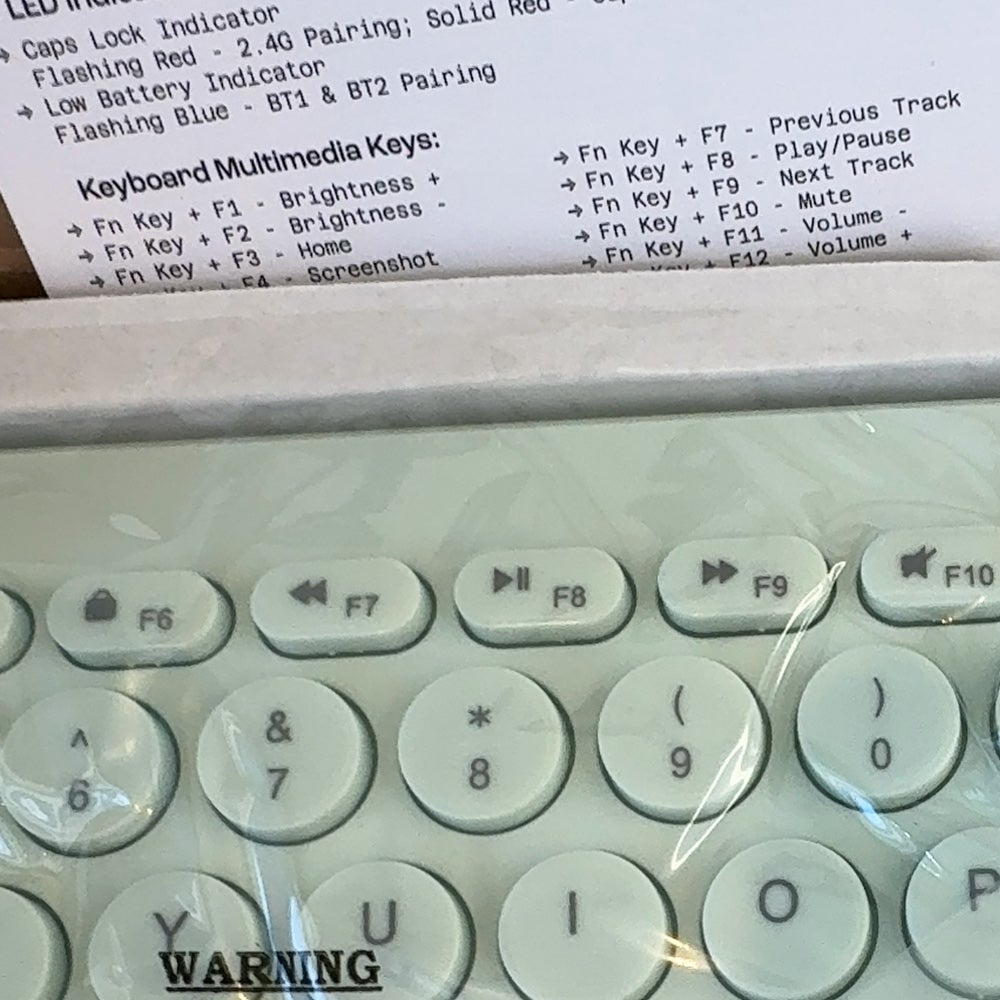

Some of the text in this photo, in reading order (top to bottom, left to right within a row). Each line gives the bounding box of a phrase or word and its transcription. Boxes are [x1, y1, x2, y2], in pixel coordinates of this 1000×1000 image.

[22, 37, 78, 60] Caps
[89, 22, 146, 49] Lock
[156, 5, 280, 40] Indicator
[32, 0, 551, 88] Flashing Red 2.4G Pairing; Solid Red
[44, 58, 326, 117] Low Battery Indicator
[54, 62, 496, 144] Flashing Blue BT1 & BT2 Pairing
[578, 89, 962, 163] Fn Key F7 Previous Track
[76, 131, 440, 202] Keyboard Multimedia Keys:
[585, 127, 911, 189] Fn Key F8 Play/Pause
[592, 150, 915, 214] Fn Key F9 Next Track
[93, 175, 414, 237] Fn Key F1 Brightness
[599, 188, 852, 240] Fn Key F10 Mute
[104, 201, 423, 262] Fn Key F2 Brightness
[605, 209, 883, 264] Fn Key F11 Volume
[729, 232, 888, 267] F12 Volume
[115, 238, 352, 286] Fn Key F3 Home
[307, 249, 439, 284] Screenshot
[553, 586, 587, 609] F8
[754, 575, 789, 598] F9
[945, 565, 995, 587] F10
[139, 609, 174, 631] F6
[346, 594, 380, 618] F7
[265, 711, 292, 743] &
[267, 768, 289, 800] 7
[469, 758, 490, 790] 8
[670, 746, 692, 778] 9
[67, 779, 90, 812] 6
[758, 878, 799, 924] O
[968, 868, 1000, 911] P
[153, 911, 190, 952] Y
[362, 899, 397, 946] U
[159, 949, 382, 991] WARNING
